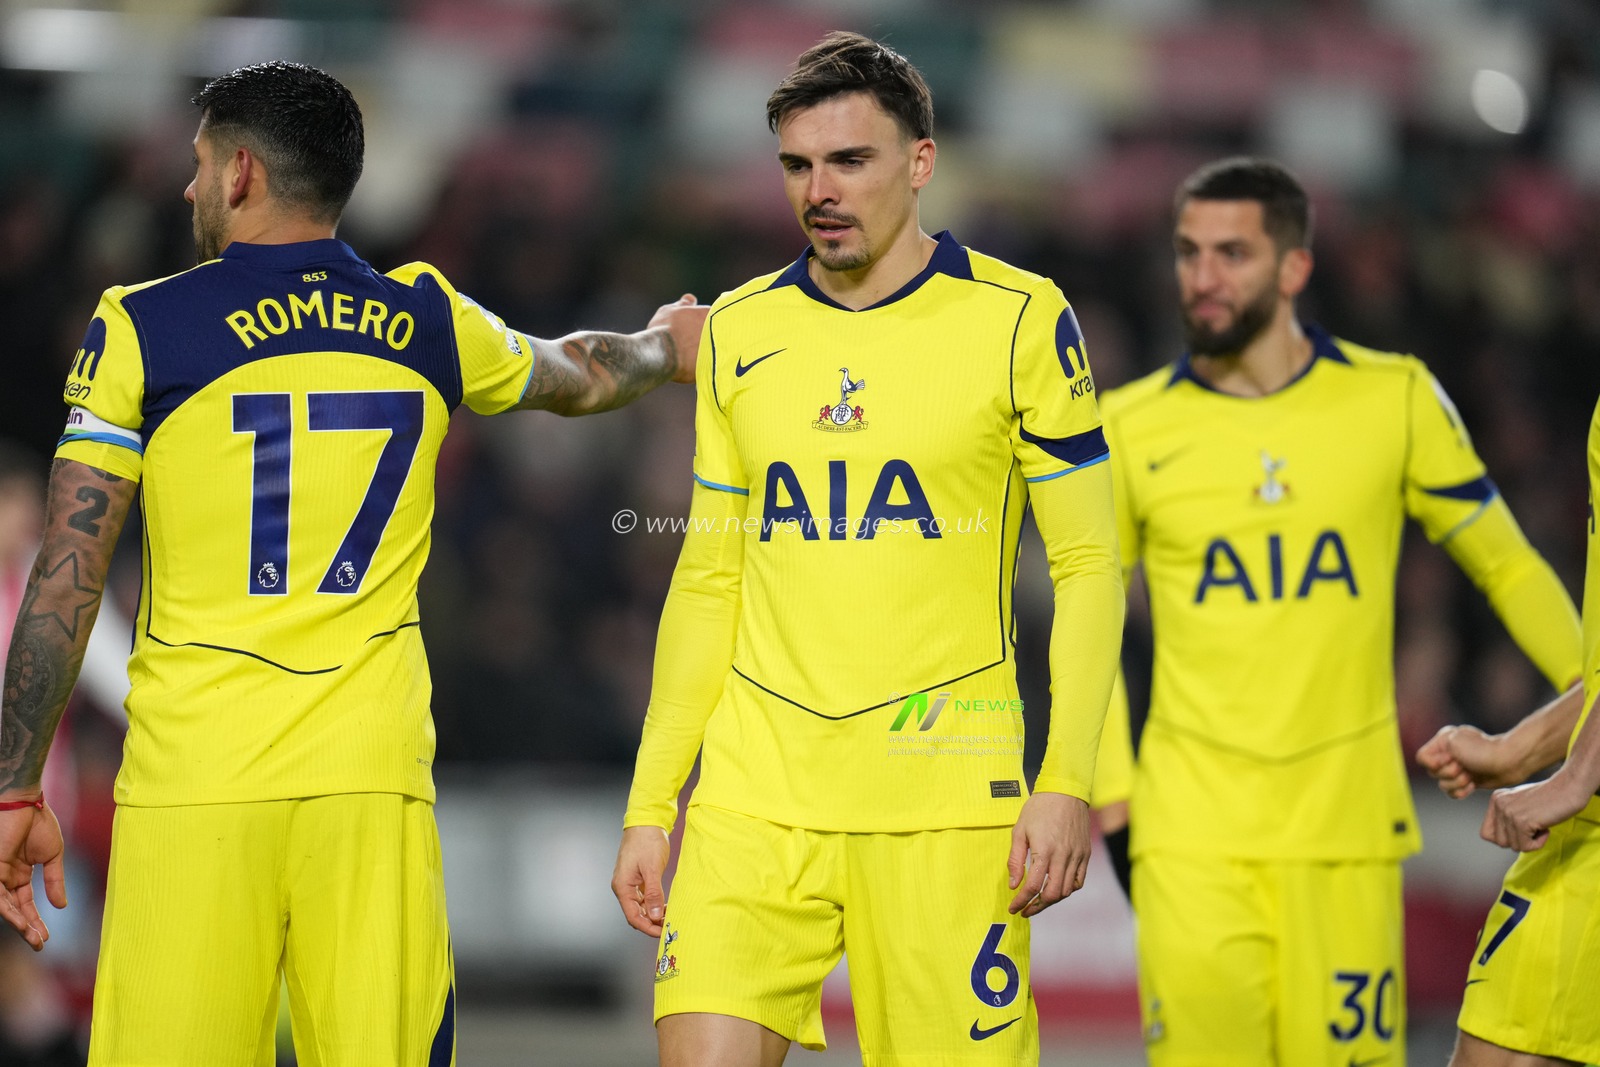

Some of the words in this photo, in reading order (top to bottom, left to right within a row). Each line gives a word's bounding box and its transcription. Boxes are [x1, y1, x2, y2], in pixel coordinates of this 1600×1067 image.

[302, 271, 328, 283] 853
[225, 290, 415, 351] ROMERO
[1069, 375, 1093, 401] kra
[67, 485, 110, 538] 2
[231, 390, 425, 596] 17
[759, 459, 943, 542] AIA
[1193, 528, 1360, 606] AIA
[970, 923, 1020, 1009] 6
[1476, 889, 1532, 967] 7
[1328, 968, 1394, 1042] 30
